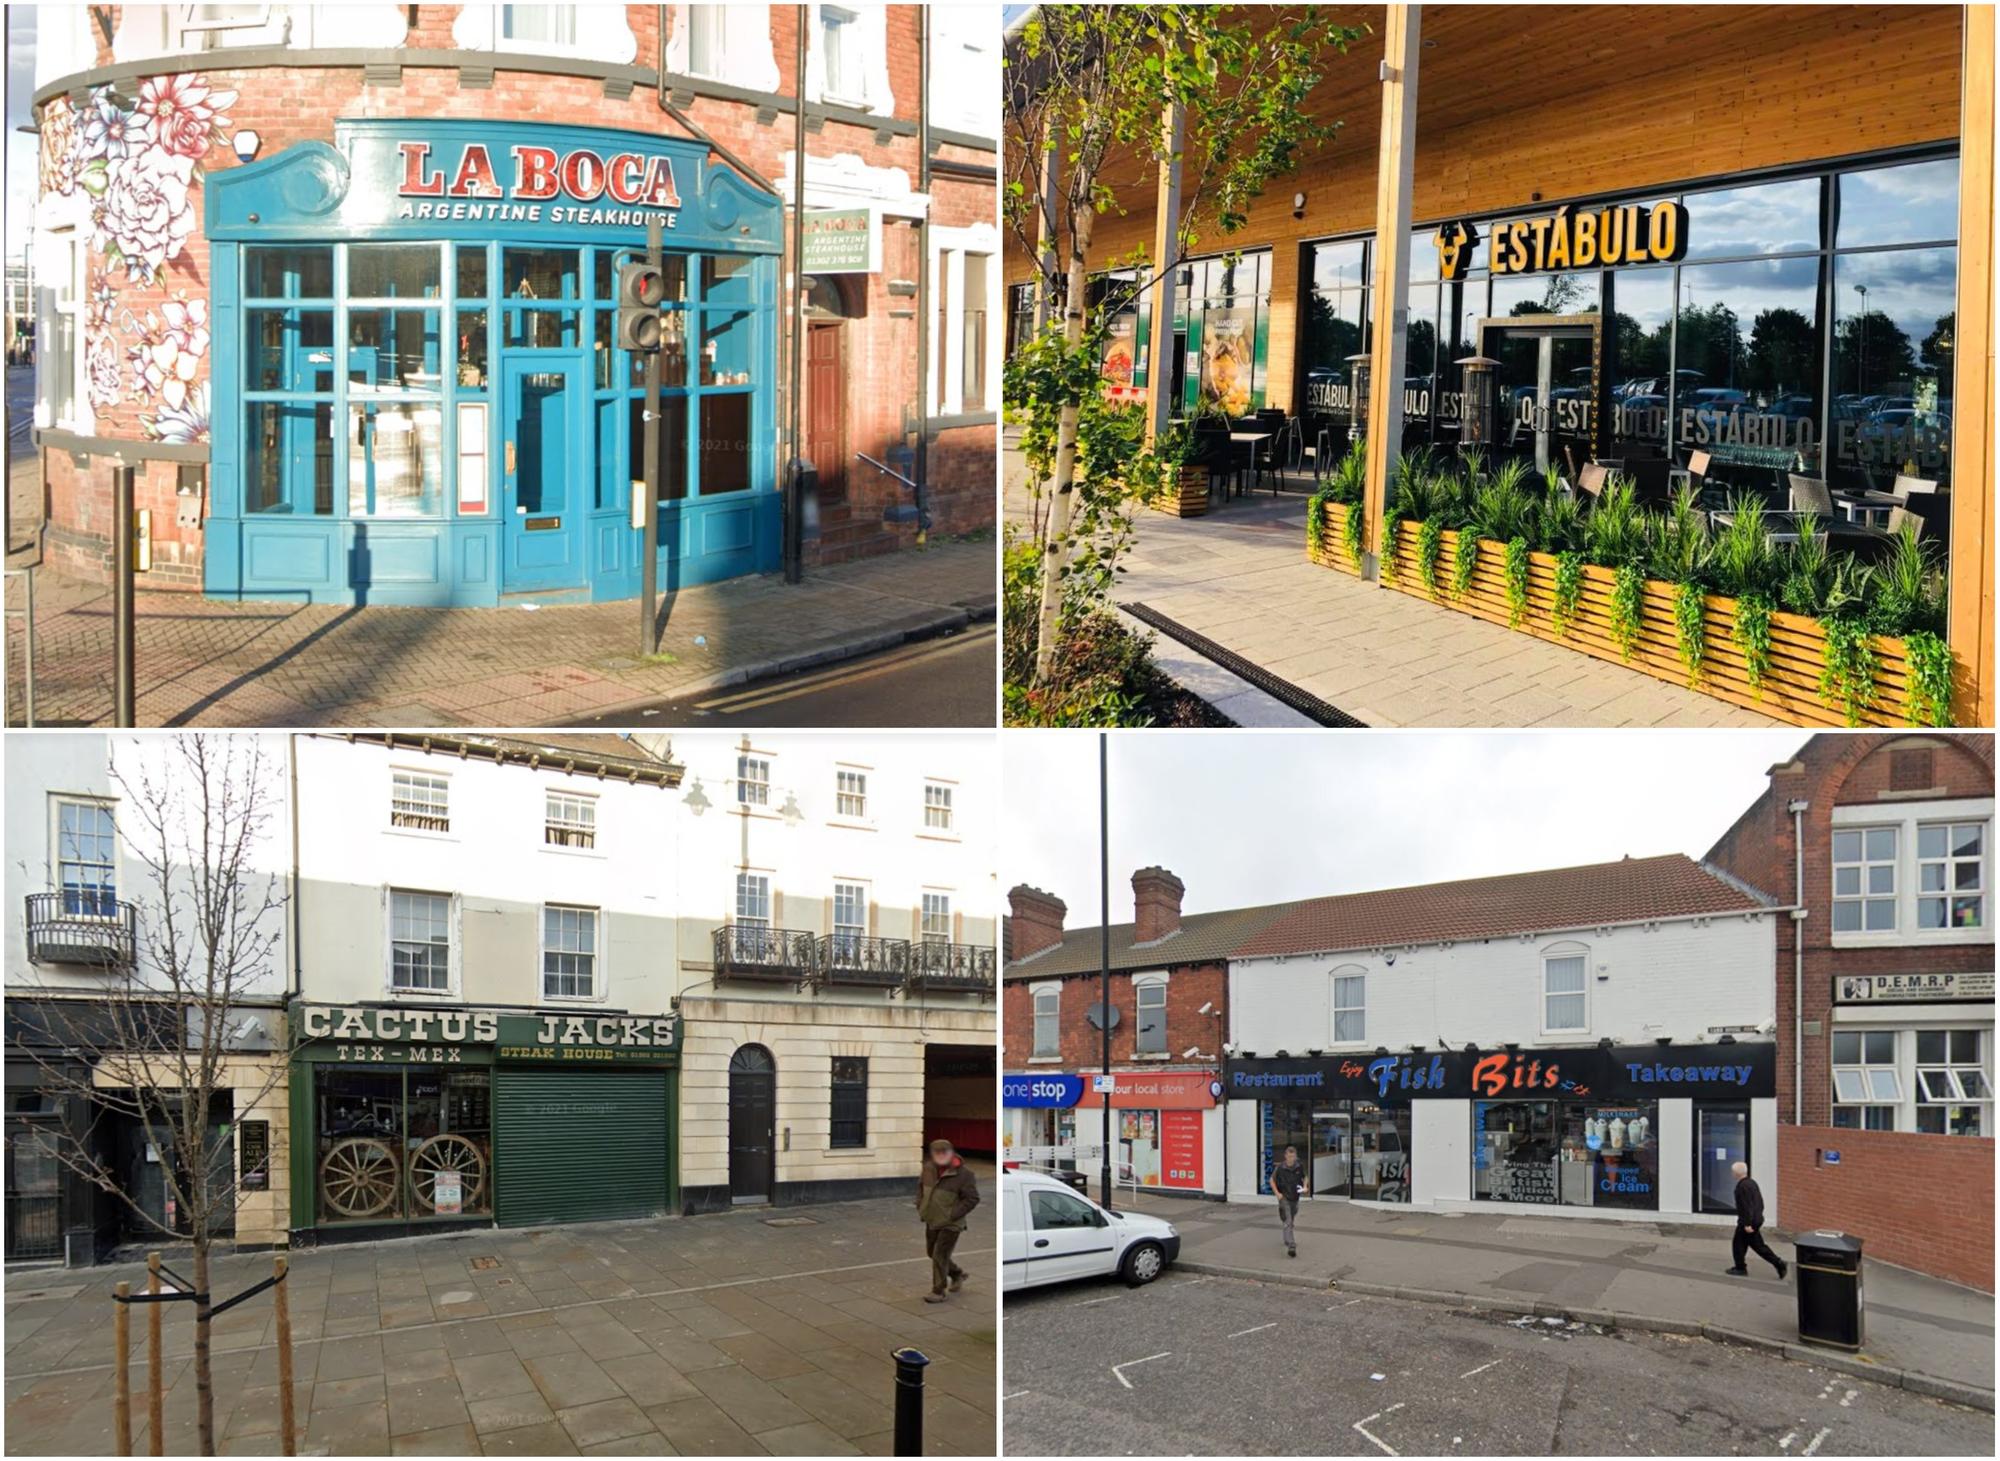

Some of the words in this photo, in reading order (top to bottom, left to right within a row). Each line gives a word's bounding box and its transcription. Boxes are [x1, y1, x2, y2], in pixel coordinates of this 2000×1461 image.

[398, 141, 503, 199] LA
[511, 145, 682, 208] BOCA
[400, 203, 541, 222] ARGENTINE
[1490, 201, 1677, 273] ESTÁBULO
[804, 244, 865, 254] STEAKHOUSE
[1681, 403, 1814, 451] ESTÁBULO
[304, 1006, 497, 1041] CACTUS
[537, 1016, 673, 1046] JACKS
[501, 1047, 555, 1058] STEAK
[563, 1048, 614, 1060] HOUSE
[1233, 1071, 1325, 1087] Restaurant
[1368, 1056, 1445, 1098] Fish
[1471, 1054, 1560, 1097] Bits
[1626, 1063, 1752, 1086] Takeaway
[1032, 1081, 1066, 1102] stop
[1135, 1082, 1158, 1095] local
[1161, 1084, 1185, 1095] store
[1600, 1180, 1649, 1192] Cream
[1509, 1193, 1554, 1203] More
